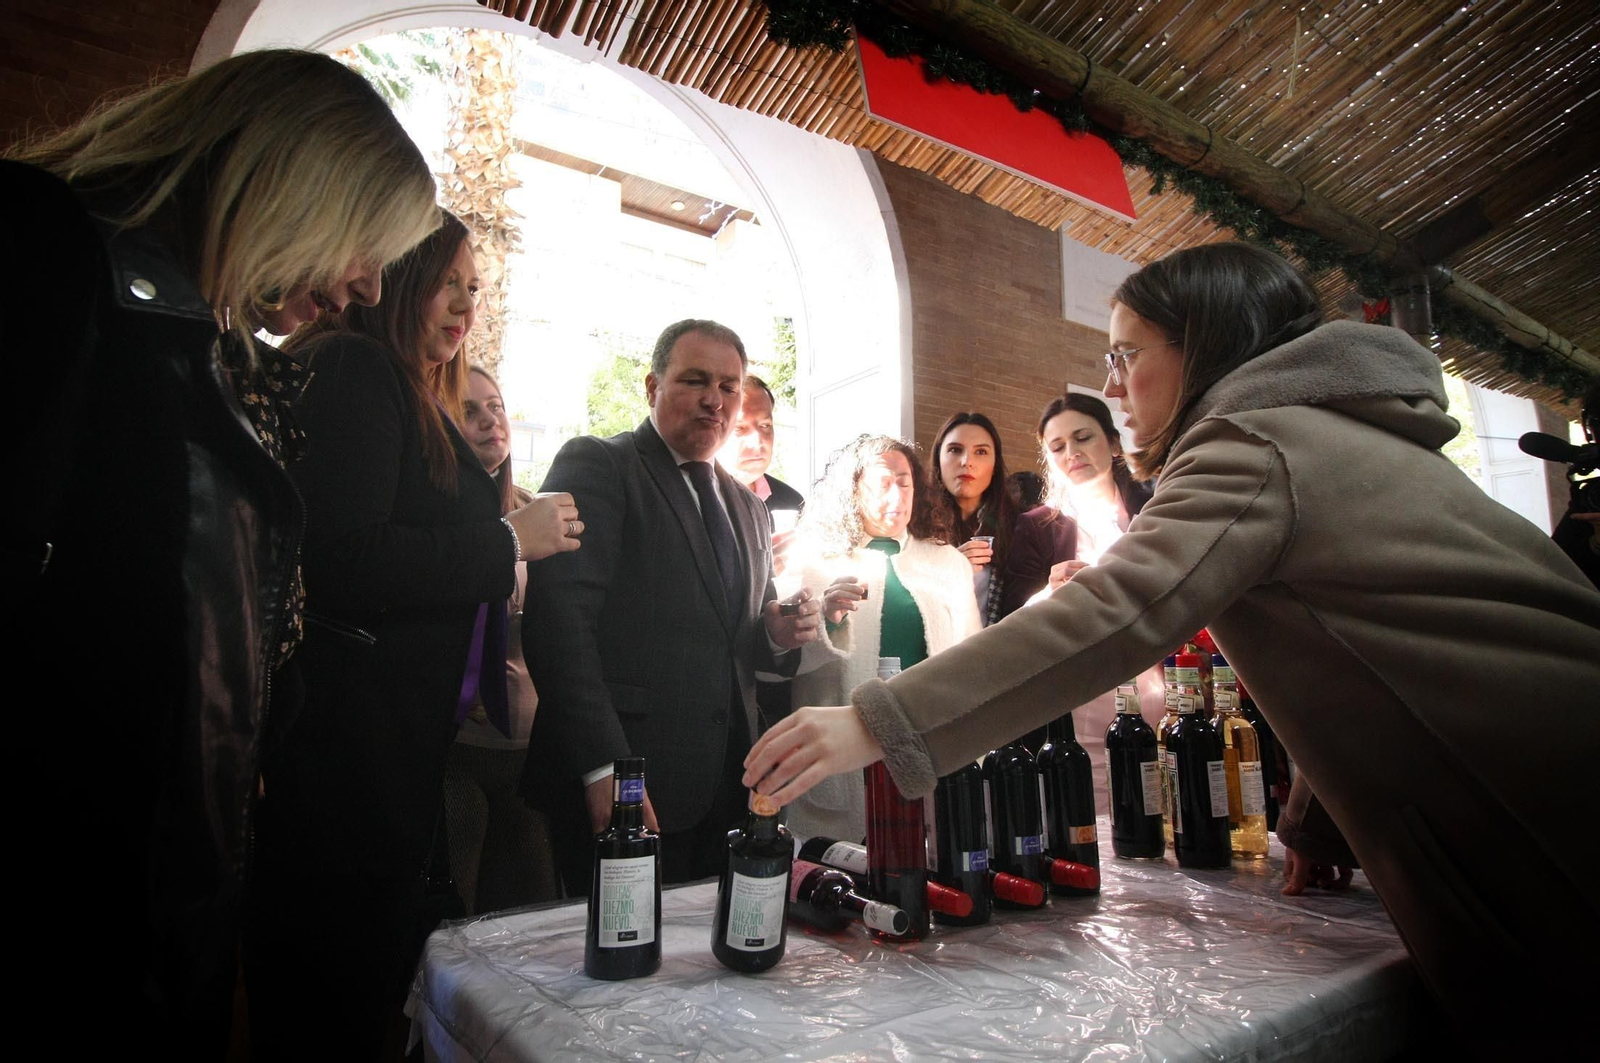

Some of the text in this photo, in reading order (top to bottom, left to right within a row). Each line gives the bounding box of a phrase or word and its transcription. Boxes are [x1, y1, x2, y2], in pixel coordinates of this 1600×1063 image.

[603, 899, 634, 915] DIEZMO
[603, 914, 632, 930] NUEVO.
[733, 908, 764, 926] DIEZMO
